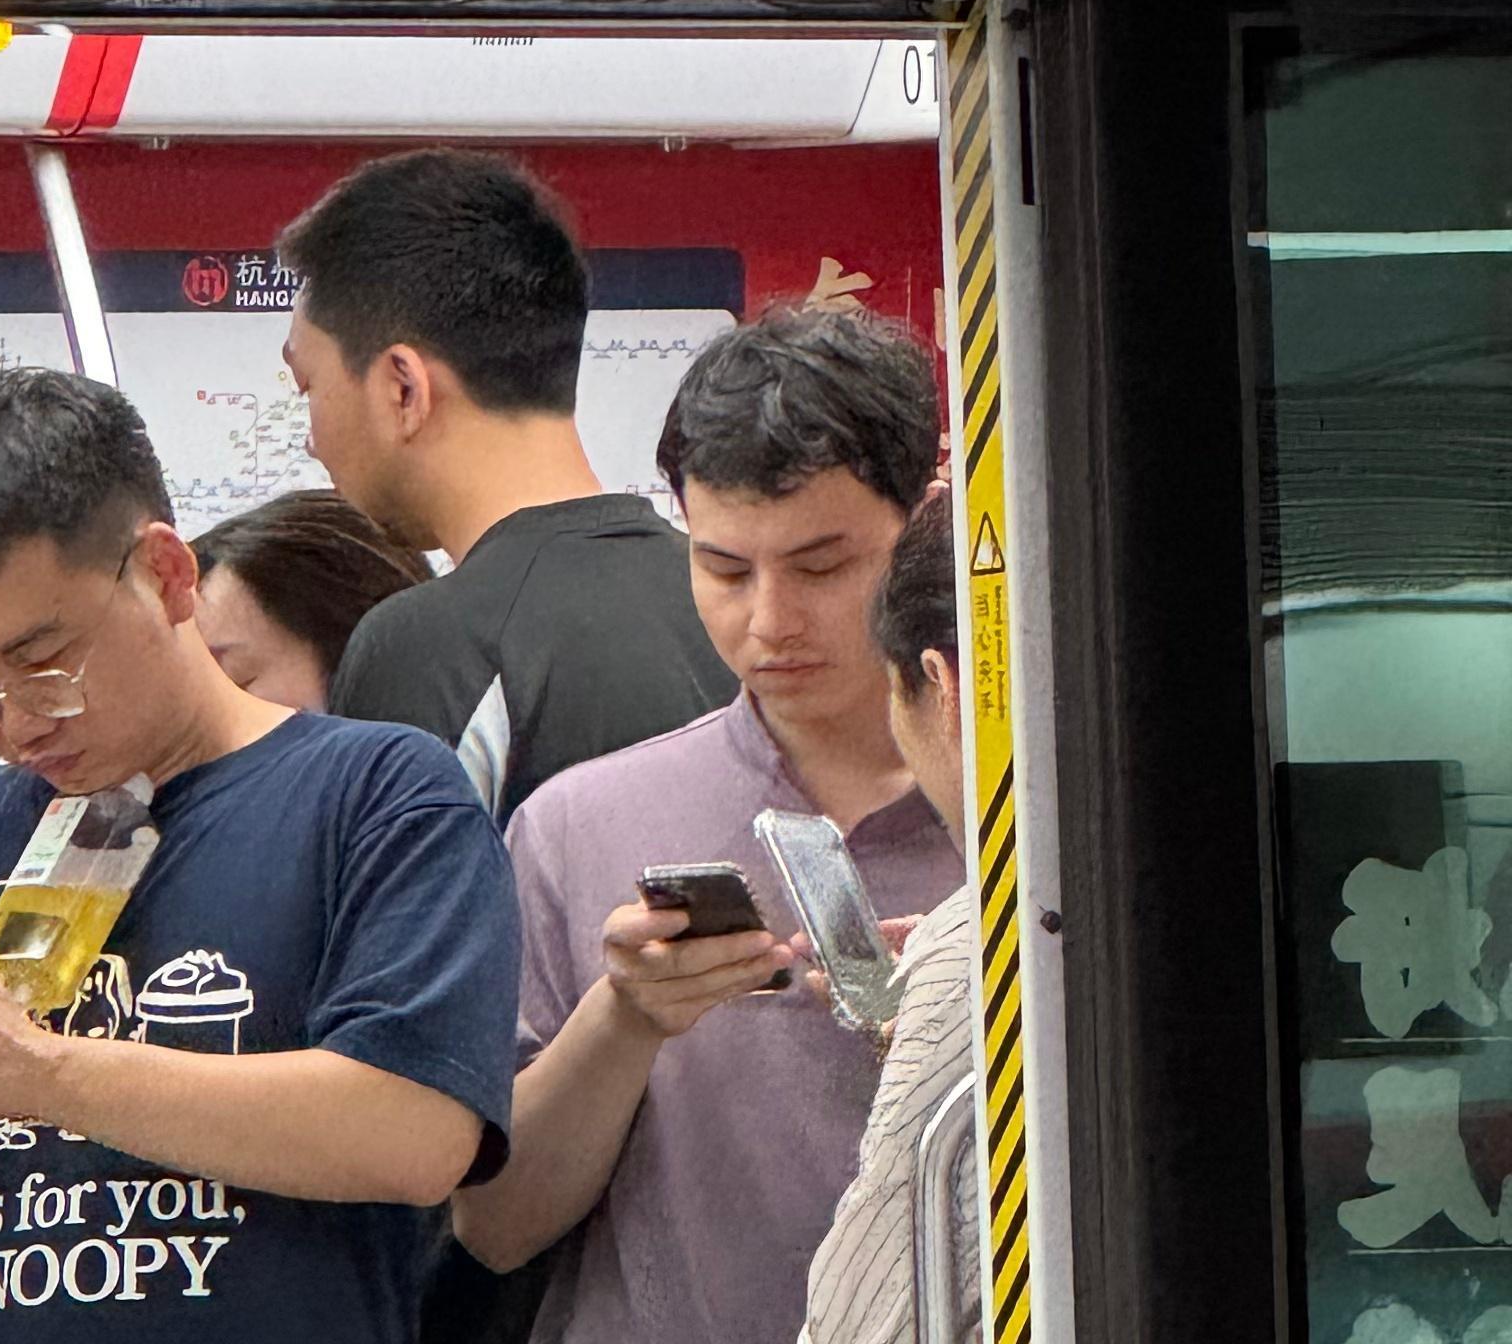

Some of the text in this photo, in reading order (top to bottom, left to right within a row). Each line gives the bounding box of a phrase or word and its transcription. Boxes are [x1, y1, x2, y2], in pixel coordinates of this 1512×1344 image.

[235, 289, 297, 307] HANG
[14, 1172, 97, 1232] for
[105, 1177, 246, 1237] you,
